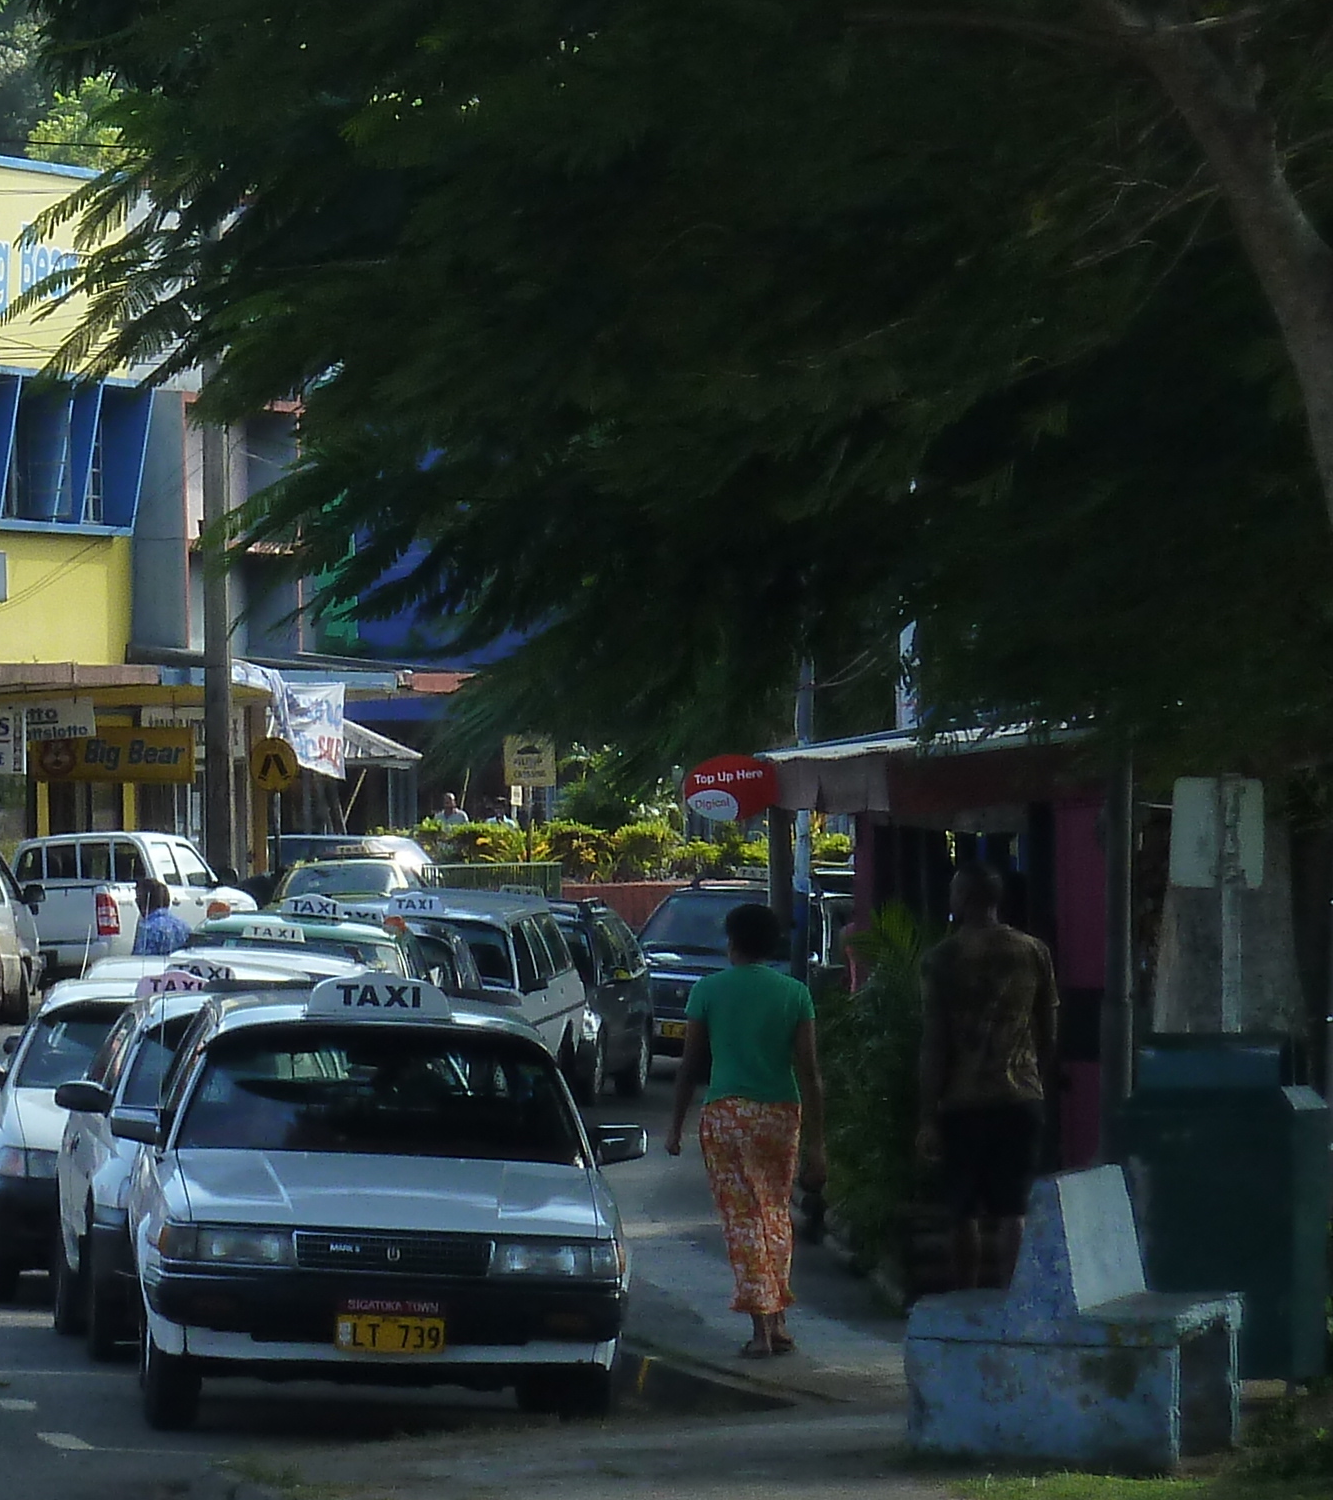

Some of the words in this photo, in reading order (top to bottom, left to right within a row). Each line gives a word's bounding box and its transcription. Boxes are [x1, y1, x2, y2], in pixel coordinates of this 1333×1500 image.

[85, 739, 121, 771] Big
[128, 739, 185, 765] Bear
[694, 773, 715, 785] Top
[717, 771, 734, 784] Up
[736, 769, 764, 780] Here
[289, 899, 338, 917] TAXI
[396, 899, 434, 911] TAXI
[251, 925, 297, 940] TAXI
[336, 983, 421, 1008] TAXI
[347, 1299, 402, 1312] SIGATOKA
[406, 1300, 439, 1313] TOWN
[352, 1322, 380, 1348] LT
[397, 1324, 440, 1349] 739
